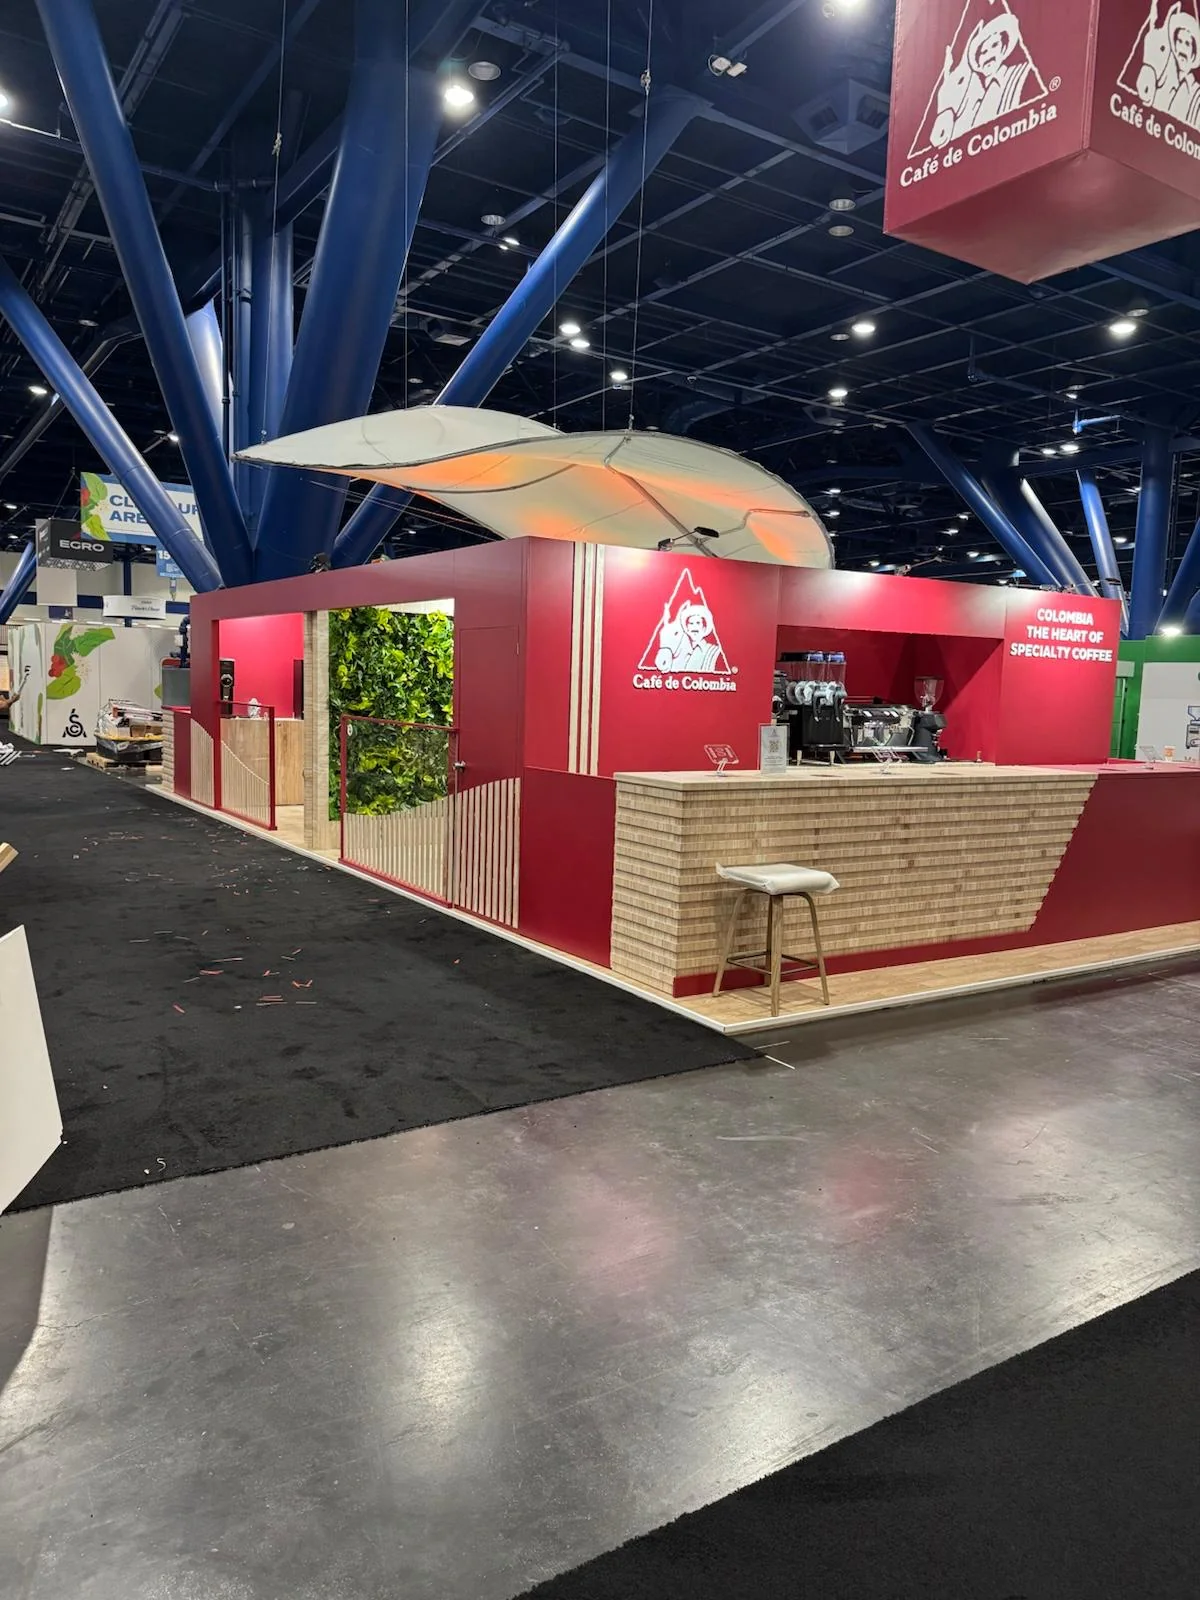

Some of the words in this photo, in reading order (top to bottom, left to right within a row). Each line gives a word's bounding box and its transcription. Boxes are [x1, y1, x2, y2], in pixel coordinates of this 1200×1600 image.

[1109, 93, 1143, 127] Café
[1145, 116, 1162, 139] de
[899, 153, 938, 187] Café
[942, 145, 963, 168] de
[967, 103, 1058, 156] Colombia
[109, 510, 148, 524] ARE
[59, 539, 105, 552] EGRO
[1037, 608, 1093, 625] COLOMBIA
[1027, 625, 1050, 640] THE
[1052, 627, 1088, 642] HEART
[1088, 631, 1104, 643] OF
[1010, 643, 1071, 659] SPECIALTY
[1072, 648, 1113, 662] COFFEE
[633, 673, 662, 689] Café
[665, 675, 680, 690] de
[682, 675, 737, 691] Colombia
